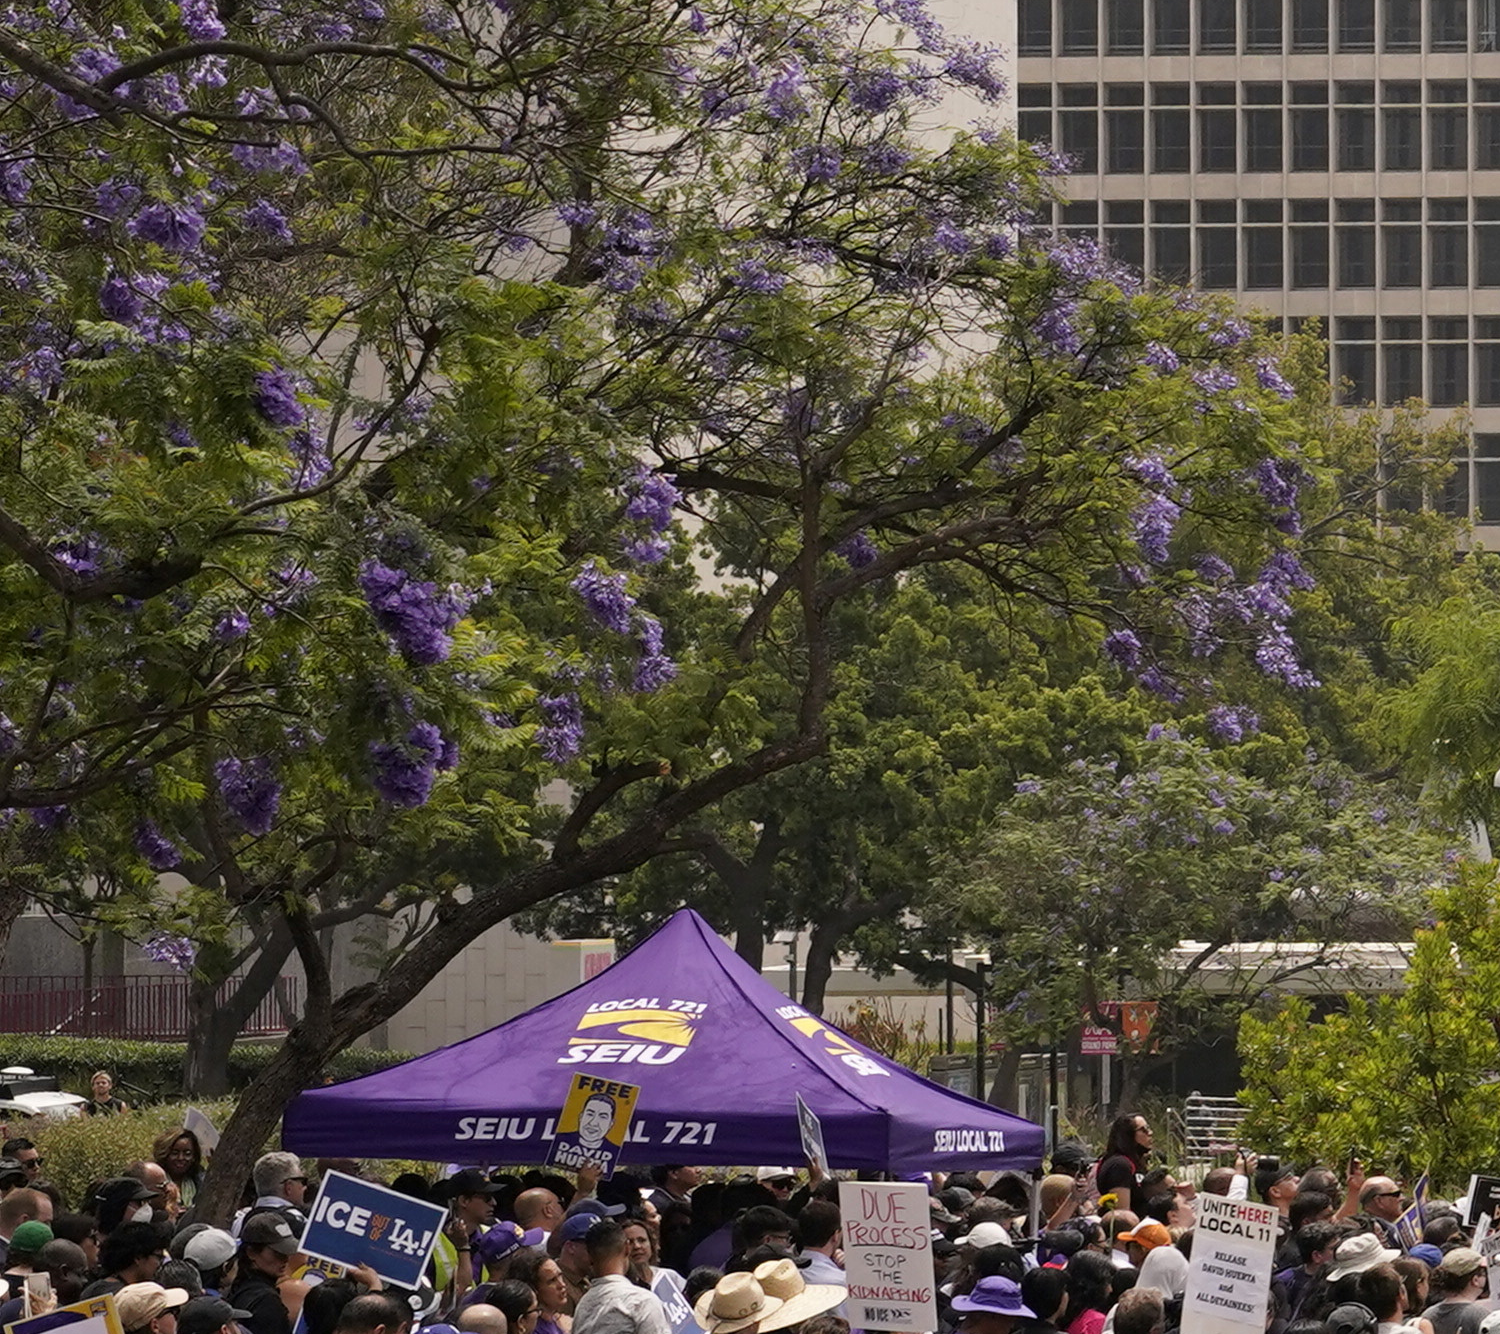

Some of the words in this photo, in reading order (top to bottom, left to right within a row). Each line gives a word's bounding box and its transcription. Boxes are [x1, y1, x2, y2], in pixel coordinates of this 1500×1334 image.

[586, 998, 660, 1013] LOCAL
[667, 999, 708, 1013] 721
[557, 1044, 688, 1065] SEIU
[577, 1075, 633, 1098] FREE
[455, 1117, 535, 1140] SEIU
[661, 1121, 717, 1145] 721
[956, 1130, 988, 1152] LOCAL
[988, 1131, 1004, 1152] 721
[558, 1141, 613, 1162] DAVID
[861, 1188, 906, 1224] DUE
[314, 1196, 372, 1237] ICE
[370, 1214, 391, 1230] OUT
[388, 1218, 433, 1257] LA!
[845, 1220, 928, 1251] PROCESS
[1199, 1216, 1255, 1240] LOCAL
[1258, 1228, 1270, 1243] 11
[863, 1253, 906, 1268] STOP
[1214, 1251, 1248, 1267] RELEASE
[872, 1269, 902, 1284] THE
[847, 1284, 932, 1304] KIDNAPPING
